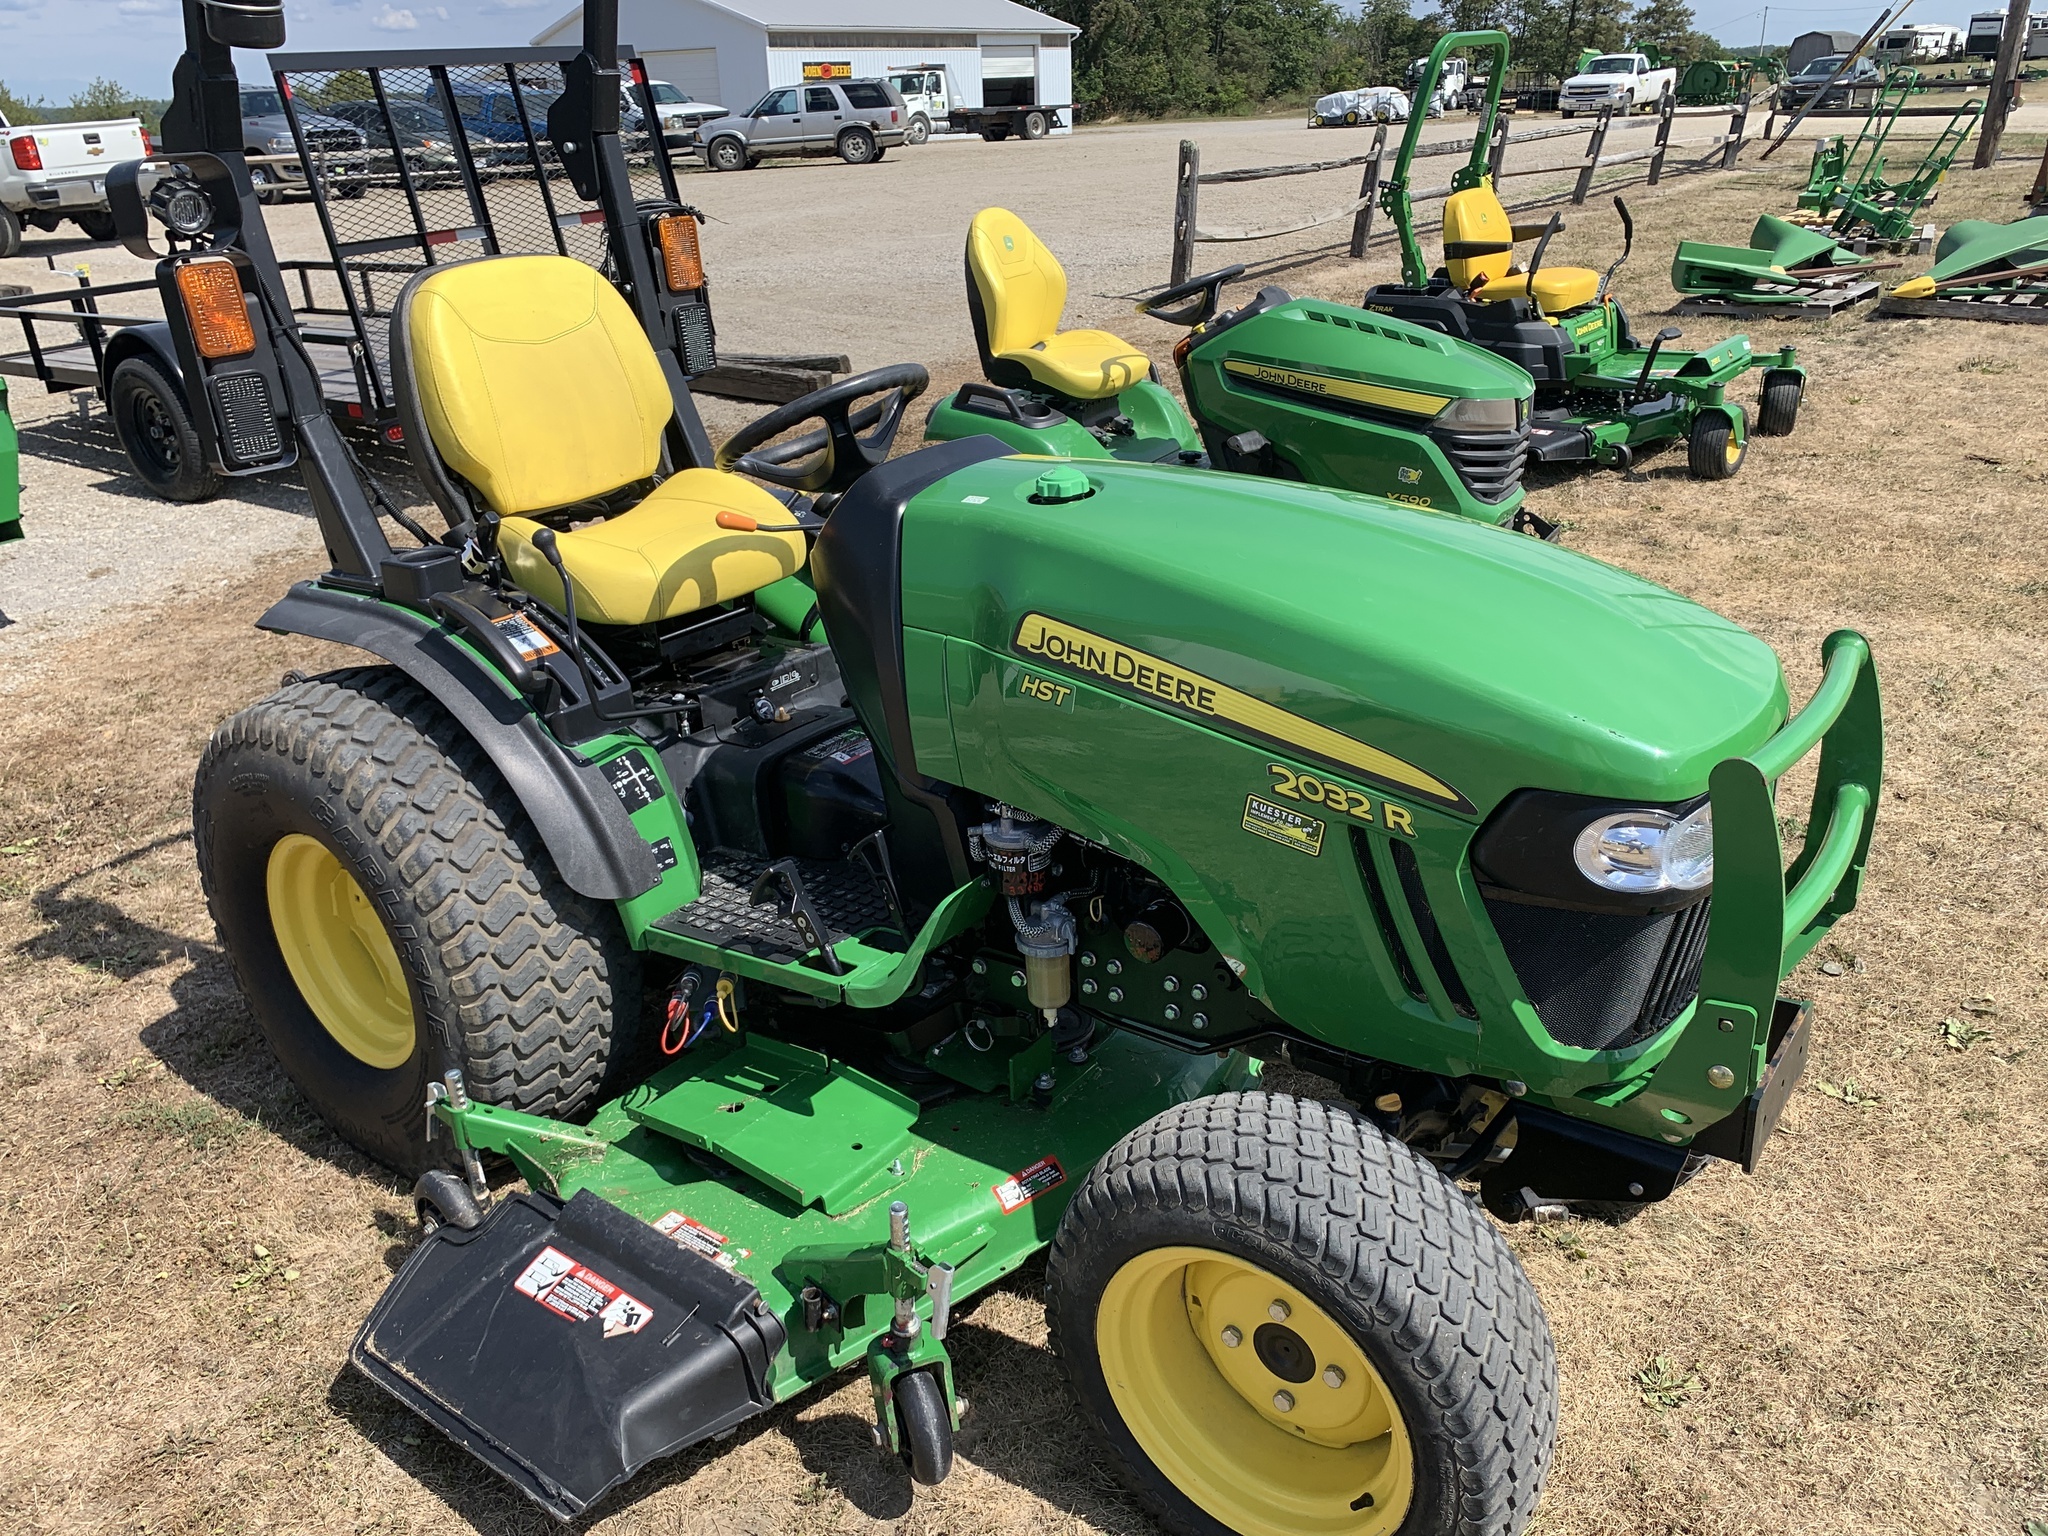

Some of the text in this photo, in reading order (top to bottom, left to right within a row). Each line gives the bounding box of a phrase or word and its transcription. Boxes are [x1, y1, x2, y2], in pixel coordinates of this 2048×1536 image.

[803, 65, 821, 77] JOHN
[1254, 367, 1326, 393] JOHN DEERE
[1029, 626, 1217, 714] JOHN DEERE
[1019, 674, 1071, 707] HST
[1251, 800, 1302, 826] KUESTER
[1268, 764, 1417, 839] 2032 R
[998, 864, 1016, 873] FILTER
[1025, 1160, 1046, 1174] DANGER
[583, 1273, 615, 1294] DANGER
